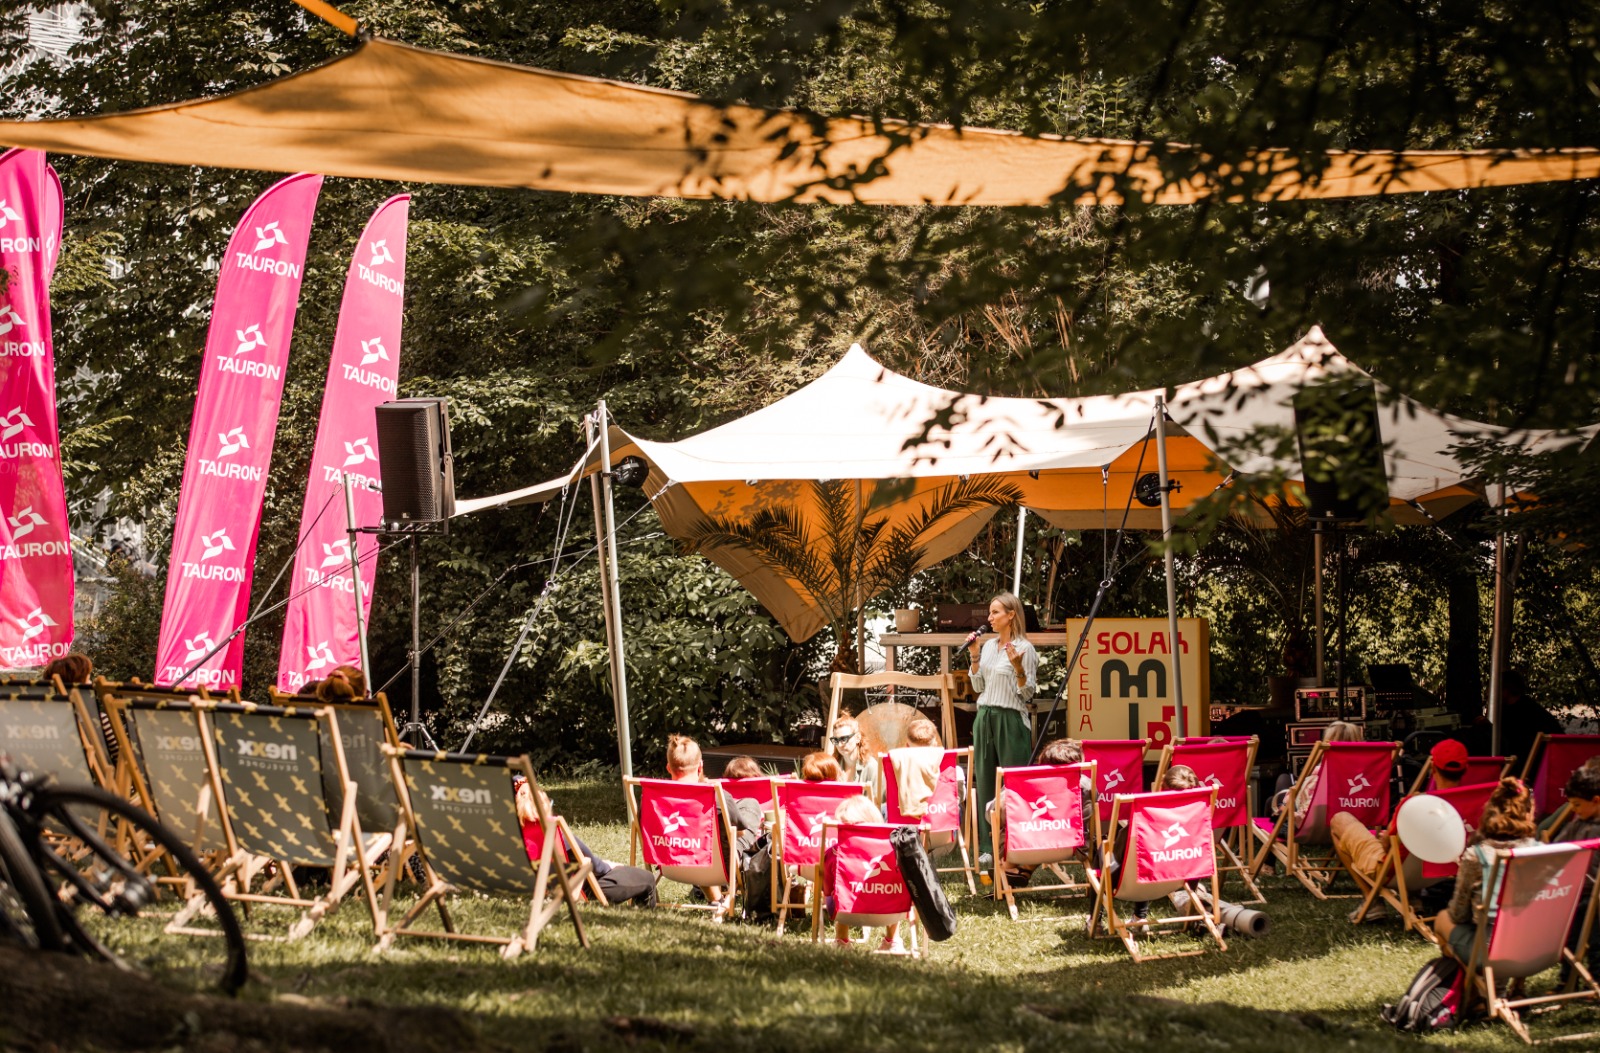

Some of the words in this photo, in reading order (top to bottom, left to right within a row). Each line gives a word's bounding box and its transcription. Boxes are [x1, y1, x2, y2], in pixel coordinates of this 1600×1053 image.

[236, 252, 300, 279] TAURON
[358, 263, 403, 298] TAURON
[217, 355, 281, 380] TAURON
[342, 364, 397, 395] TAURON
[198, 459, 261, 481] TAURON
[182, 562, 245, 582] TAURON
[166, 666, 235, 684] TAURON
[1338, 797, 1380, 808] TAURON
[1019, 818, 1071, 832] TAURON
[652, 835, 701, 849] TAURON
[1150, 847, 1202, 863] TAURON
[849, 881, 903, 895] TAURON
